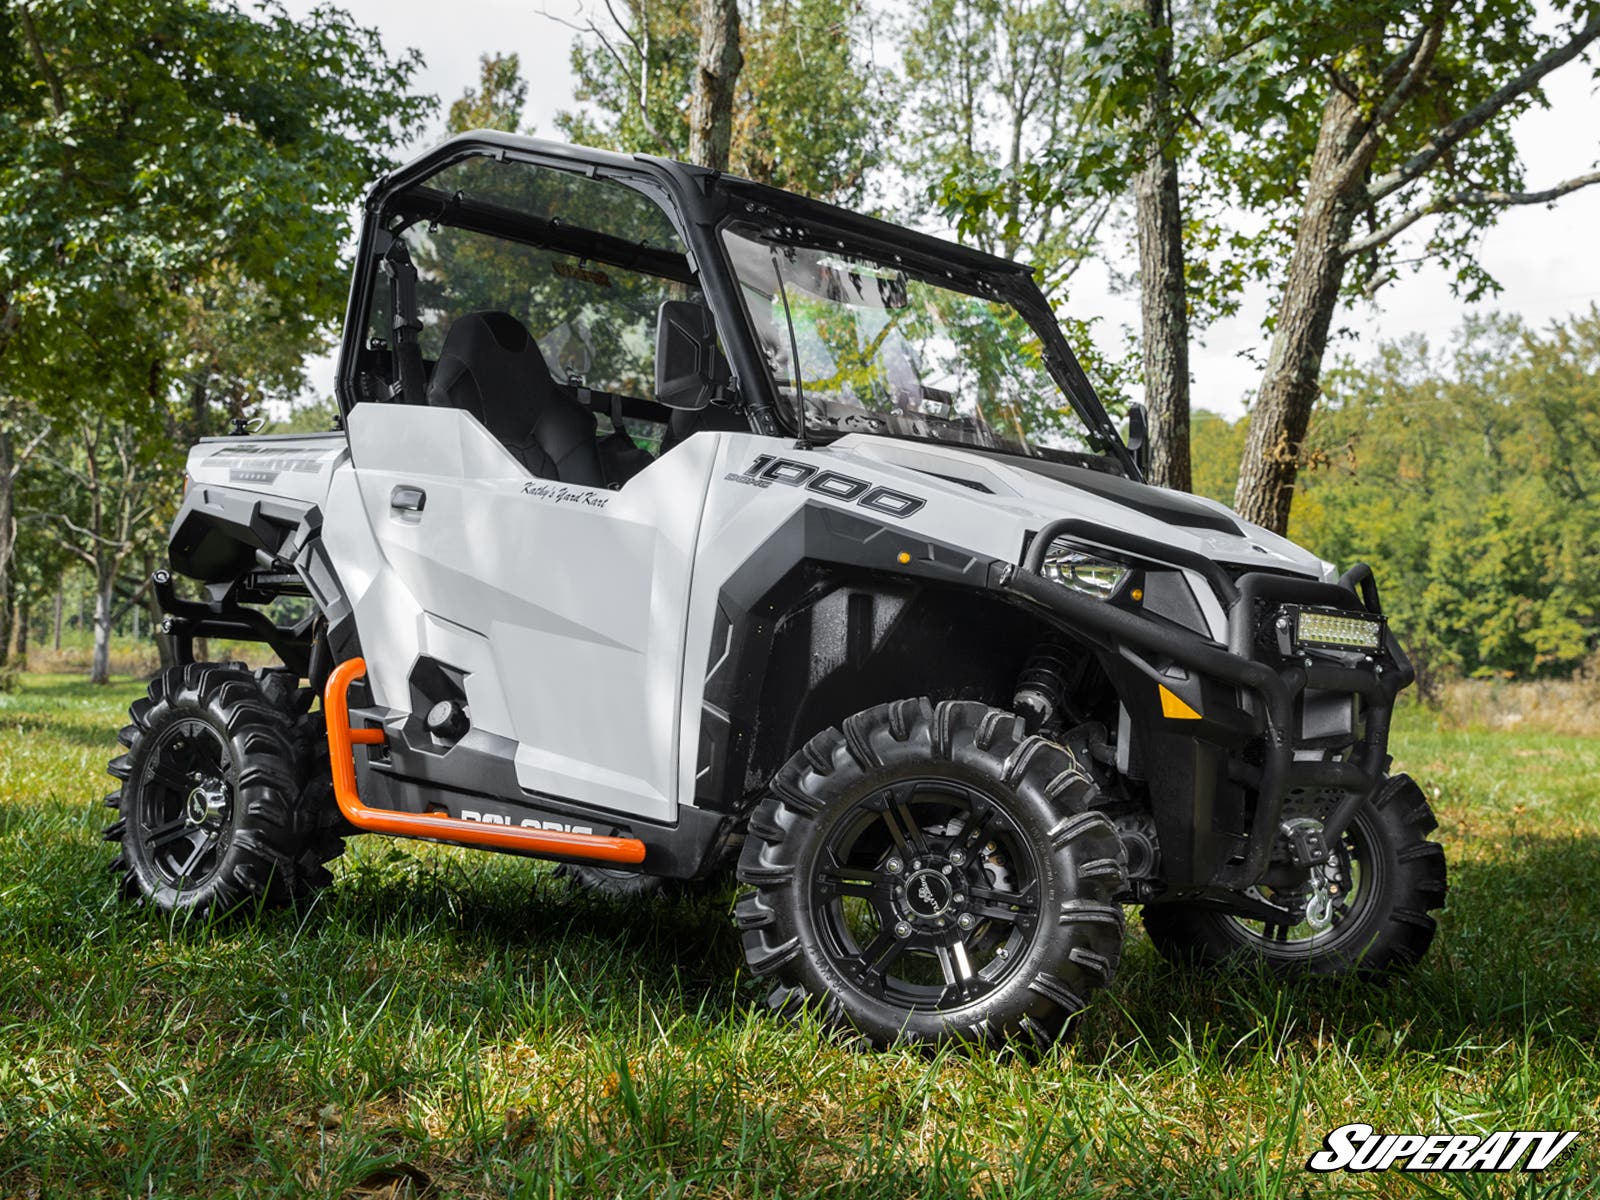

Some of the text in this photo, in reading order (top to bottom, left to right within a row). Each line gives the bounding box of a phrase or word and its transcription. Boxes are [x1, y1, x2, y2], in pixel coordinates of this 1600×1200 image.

[521, 481, 608, 508] Kathy's Yard Kart
[743, 453, 928, 519] 1000
